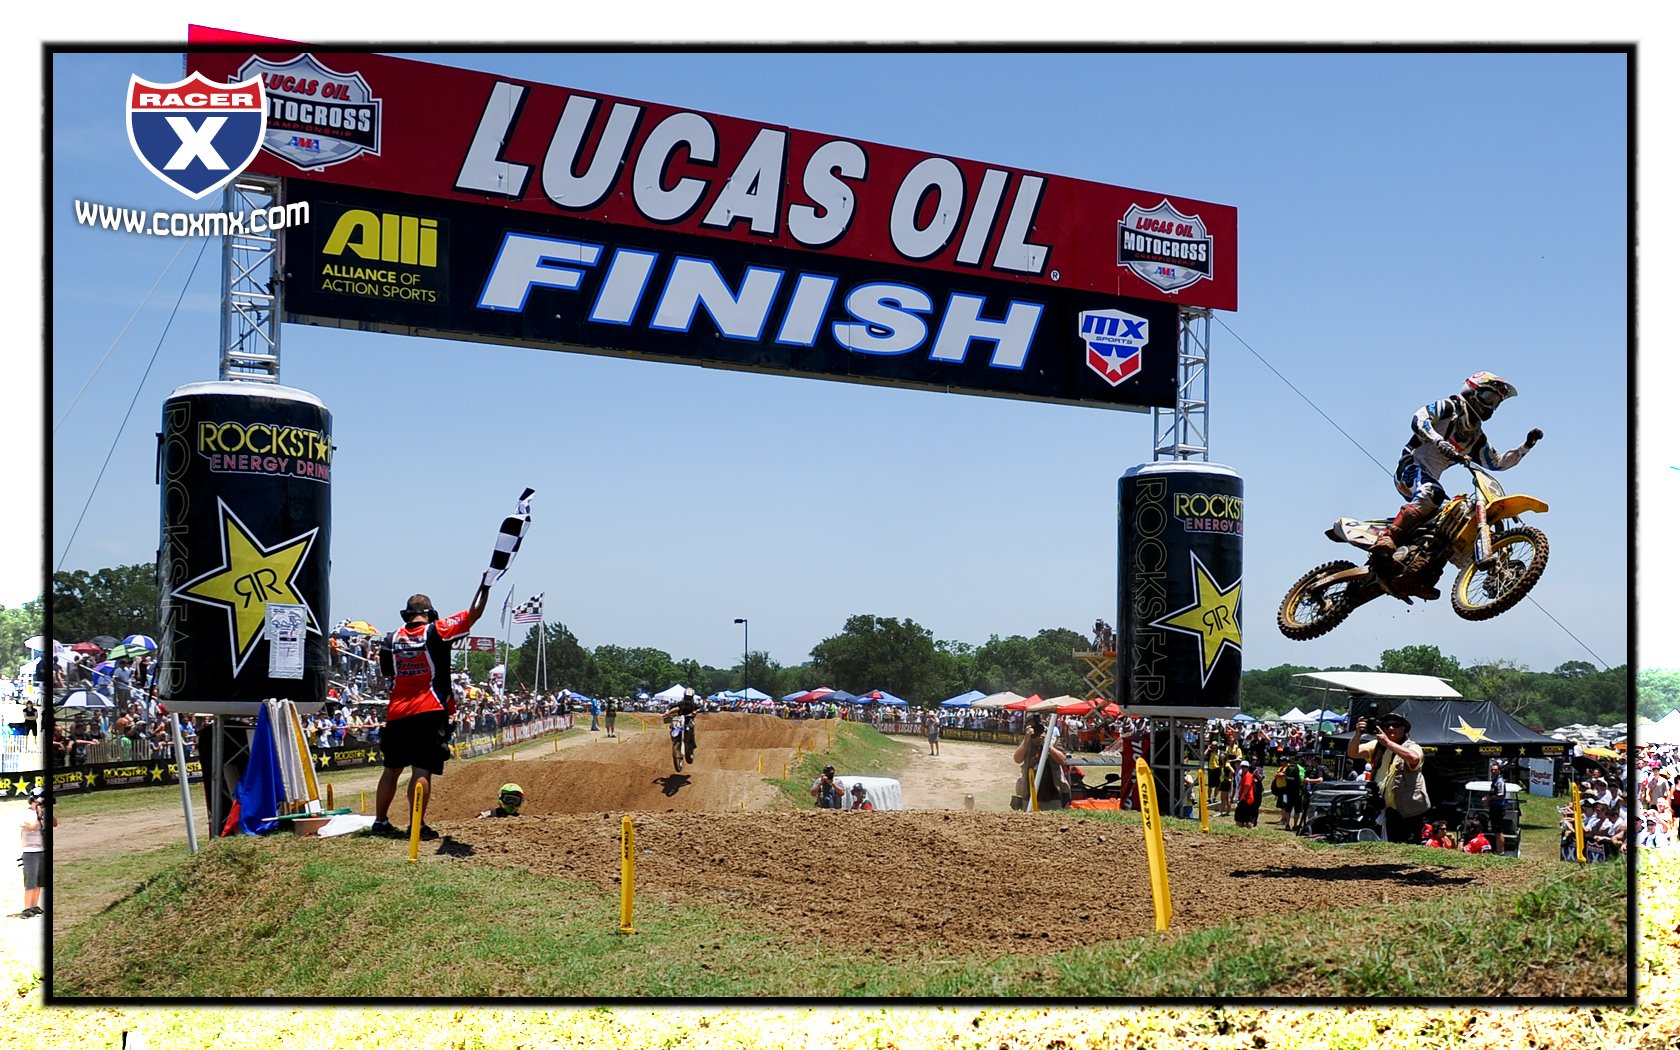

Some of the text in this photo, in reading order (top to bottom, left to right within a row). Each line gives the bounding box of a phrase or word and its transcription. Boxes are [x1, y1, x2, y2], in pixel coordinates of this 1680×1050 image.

[262, 72, 350, 101] LUCAS OIL
[267, 97, 371, 132] TOCROSS
[268, 120, 353, 137] AMPIONSHIP
[454, 80, 1053, 274] LUCAS OIL
[322, 209, 438, 268] Alli
[1136, 217, 1194, 238] LUCAS OIL
[1124, 231, 1206, 262] MOTOCROSS
[322, 263, 420, 286] ALLIANCE OF
[322, 278, 437, 303] ACTION SPORTS
[476, 231, 1045, 371] FINISH
[1096, 335, 1132, 345] SPORTS
[211, 454, 289, 473] ENERGY
[1186, 518, 1233, 532] ENERGY
[1141, 783, 1152, 830] ACERBIS
